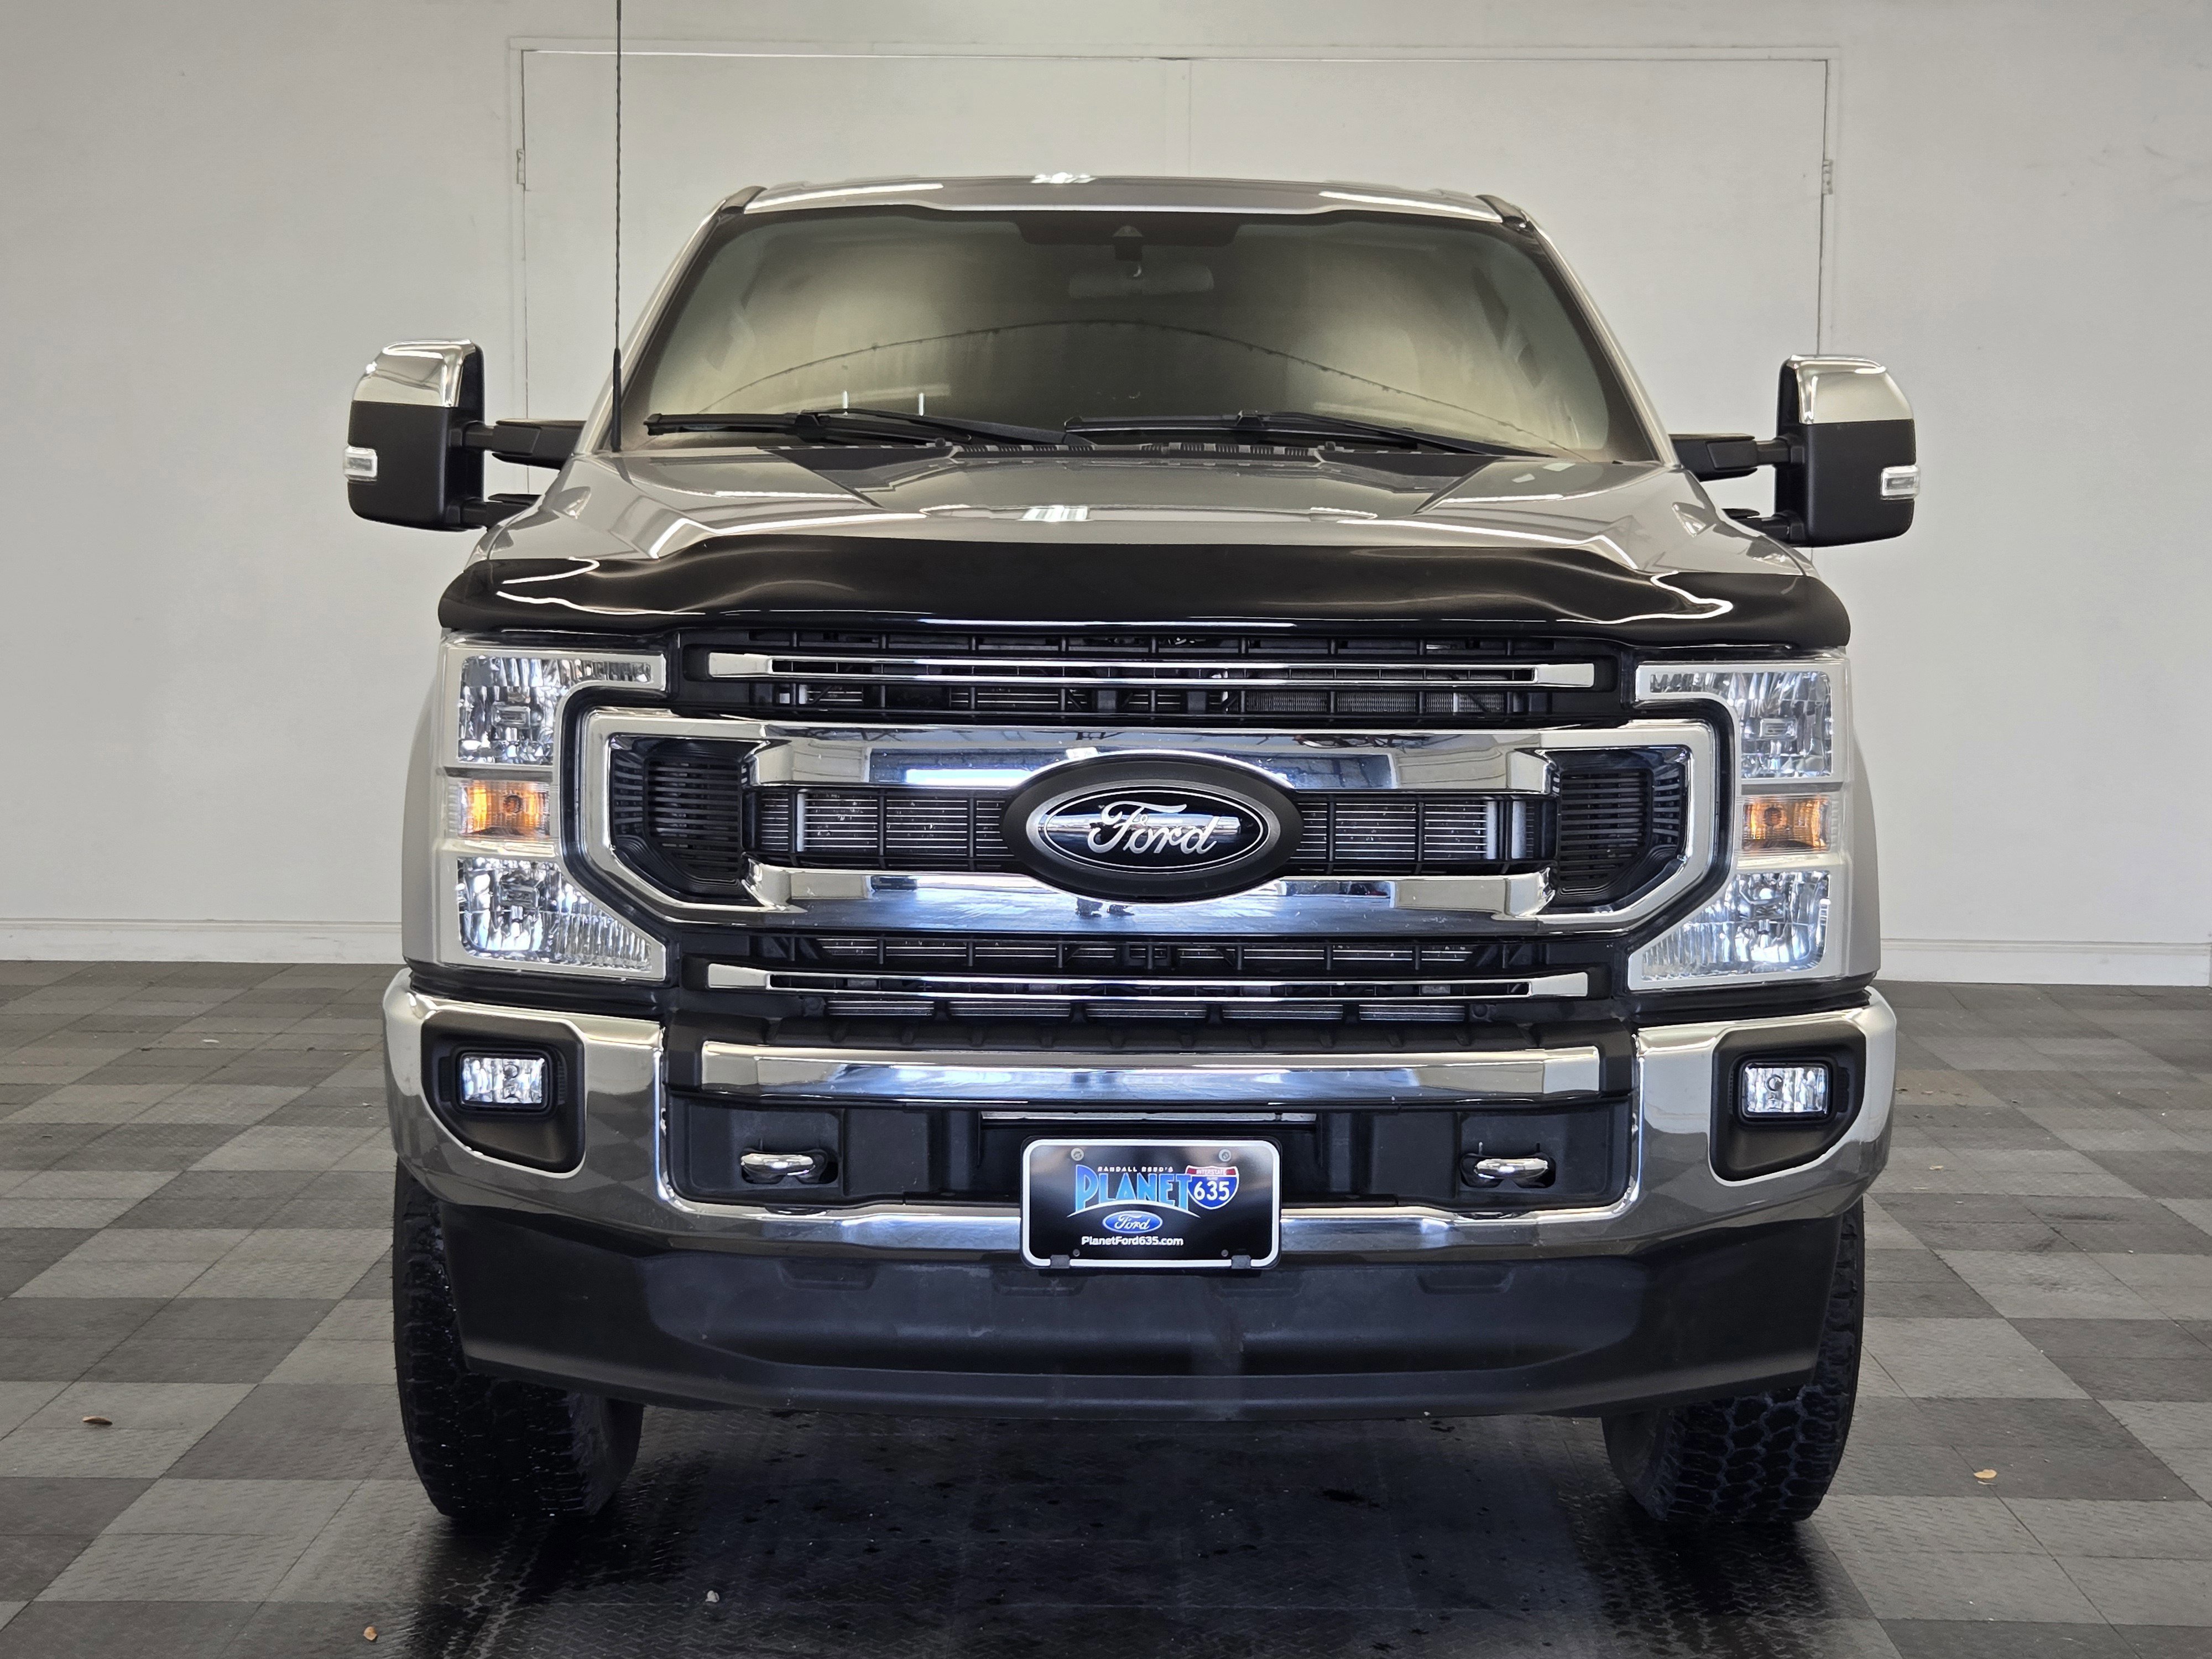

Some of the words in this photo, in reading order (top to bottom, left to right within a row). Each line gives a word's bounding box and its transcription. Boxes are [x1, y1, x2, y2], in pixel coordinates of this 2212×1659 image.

[1087, 800, 1221, 855] Ford
[1075, 1164, 1192, 1213] PLANET
[1193, 1181, 1230, 1201] 635
[1114, 1213, 1151, 1230] Ford
[1081, 1235, 1184, 1246] PlanetFord635.com
